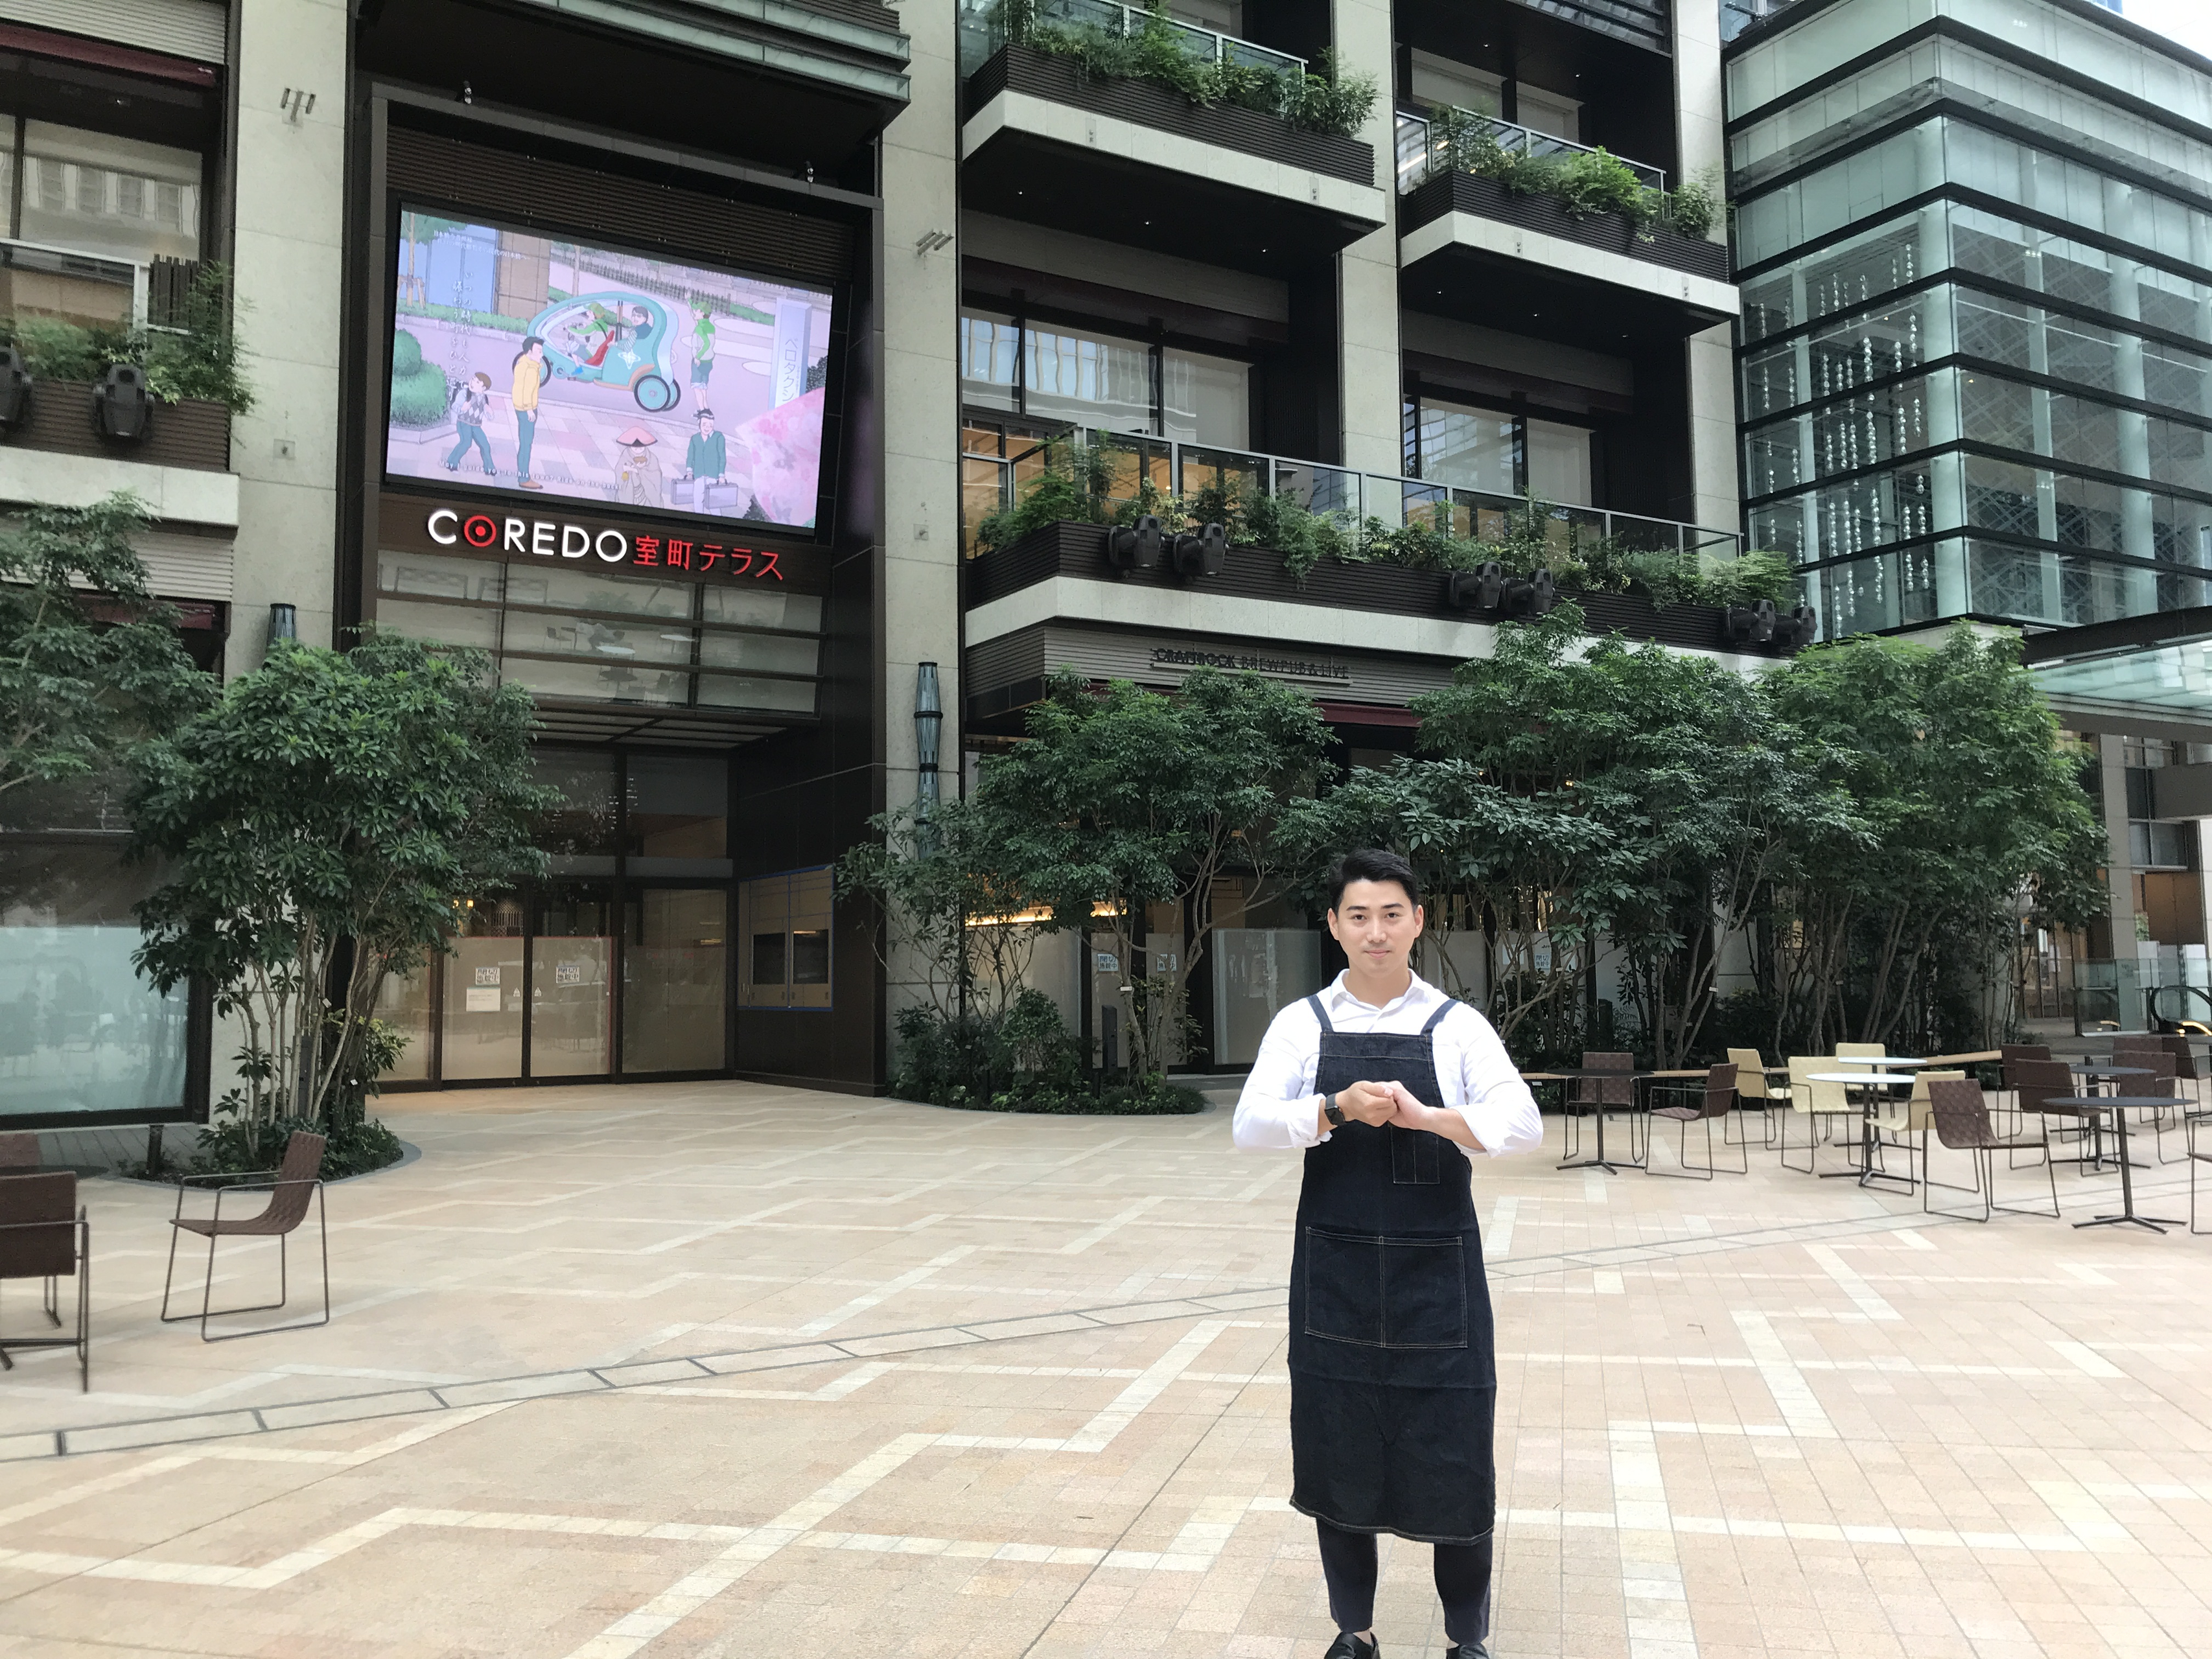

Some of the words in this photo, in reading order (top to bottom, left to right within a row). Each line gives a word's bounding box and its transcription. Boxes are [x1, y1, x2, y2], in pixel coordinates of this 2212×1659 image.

[439, 461, 454, 469] May
[463, 464, 484, 473] guide
[532, 473, 554, 481] town?
[427, 509, 627, 563] COREDO
[633, 535, 784, 581] 室町テラス
